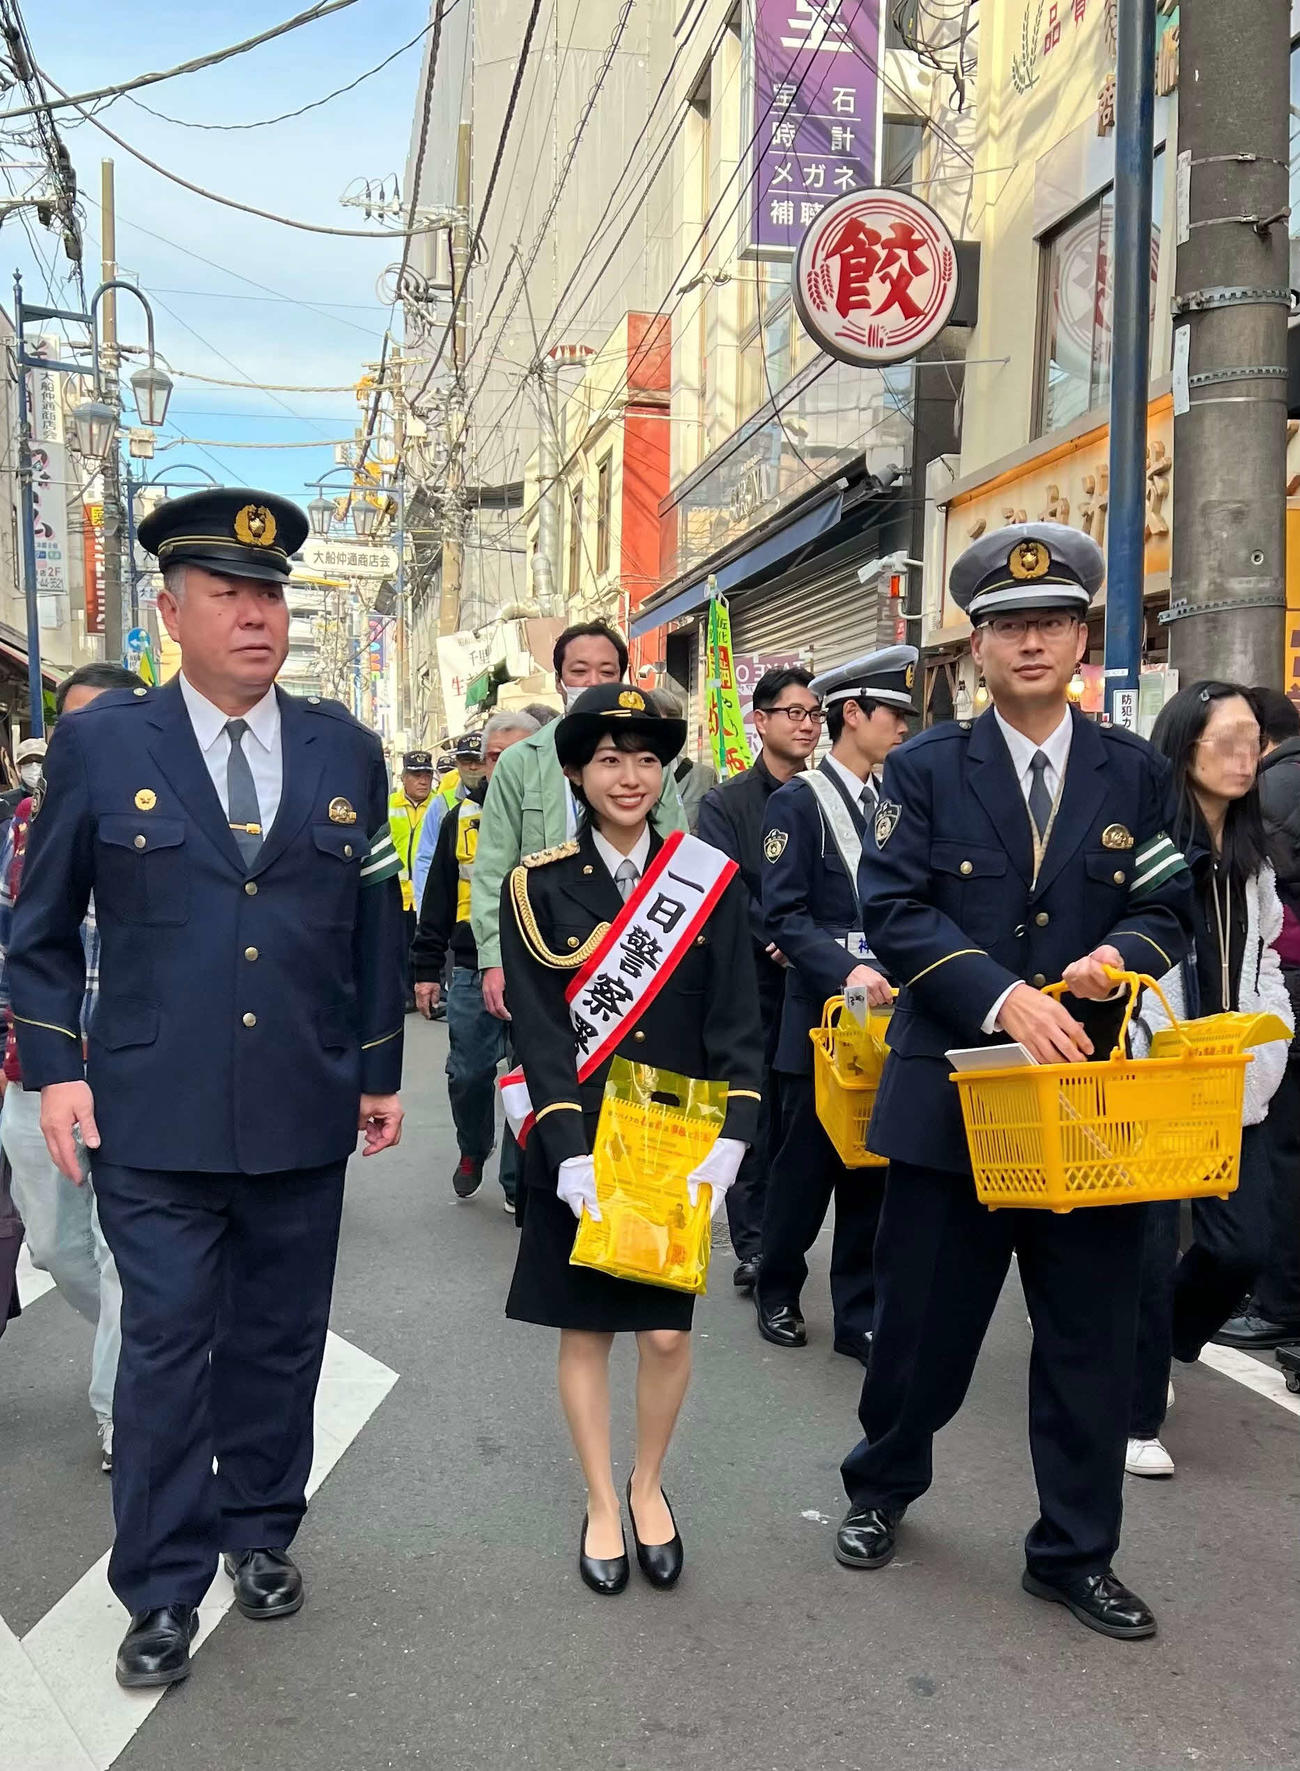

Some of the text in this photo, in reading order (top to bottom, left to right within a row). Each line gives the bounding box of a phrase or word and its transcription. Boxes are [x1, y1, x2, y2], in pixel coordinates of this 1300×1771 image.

[772, 82, 857, 113] 宝石
[771, 122, 856, 152] 時計
[771, 162, 857, 190] メガネ
[821, 216, 930, 321] 餃
[313, 551, 391, 568] 大船仲通商店会
